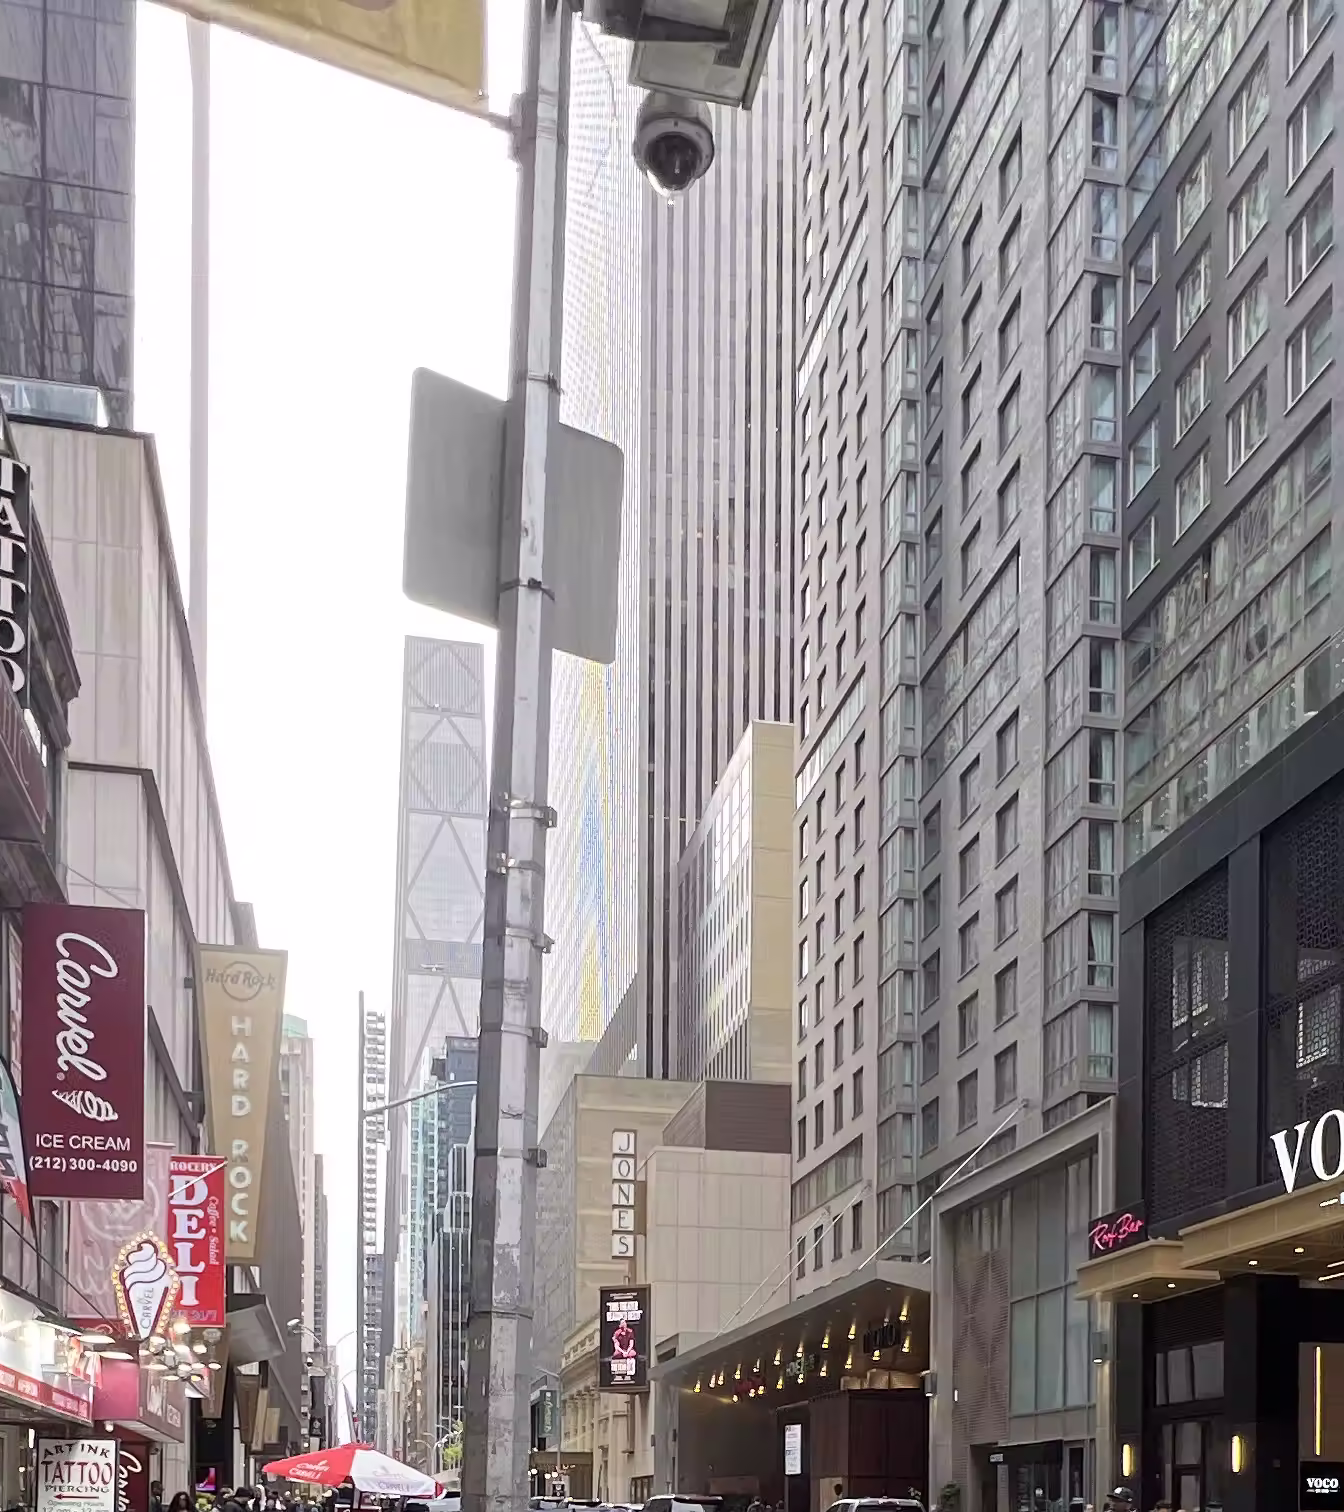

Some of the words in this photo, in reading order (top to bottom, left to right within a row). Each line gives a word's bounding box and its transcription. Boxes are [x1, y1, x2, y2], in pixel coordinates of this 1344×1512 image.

[56, 932, 120, 1085] Carvel
[231, 1015, 252, 1118] HARD
[35, 1133, 63, 1150] ICE
[68, 1133, 131, 1151] CREAM
[29, 1155, 67, 1173] (212)
[69, 1157, 137, 1174] 300-4090
[229, 1139, 252, 1244] ROCK
[617, 1132, 631, 1255] JONES
[169, 1174, 209, 1306] DELI
[43, 1442, 75, 1460] ART
[80, 1442, 111, 1459] INK
[40, 1460, 113, 1486] TATTOO
[1306, 1477, 1339, 1489] VOCO
[44, 1485, 110, 1493] PIERCING
